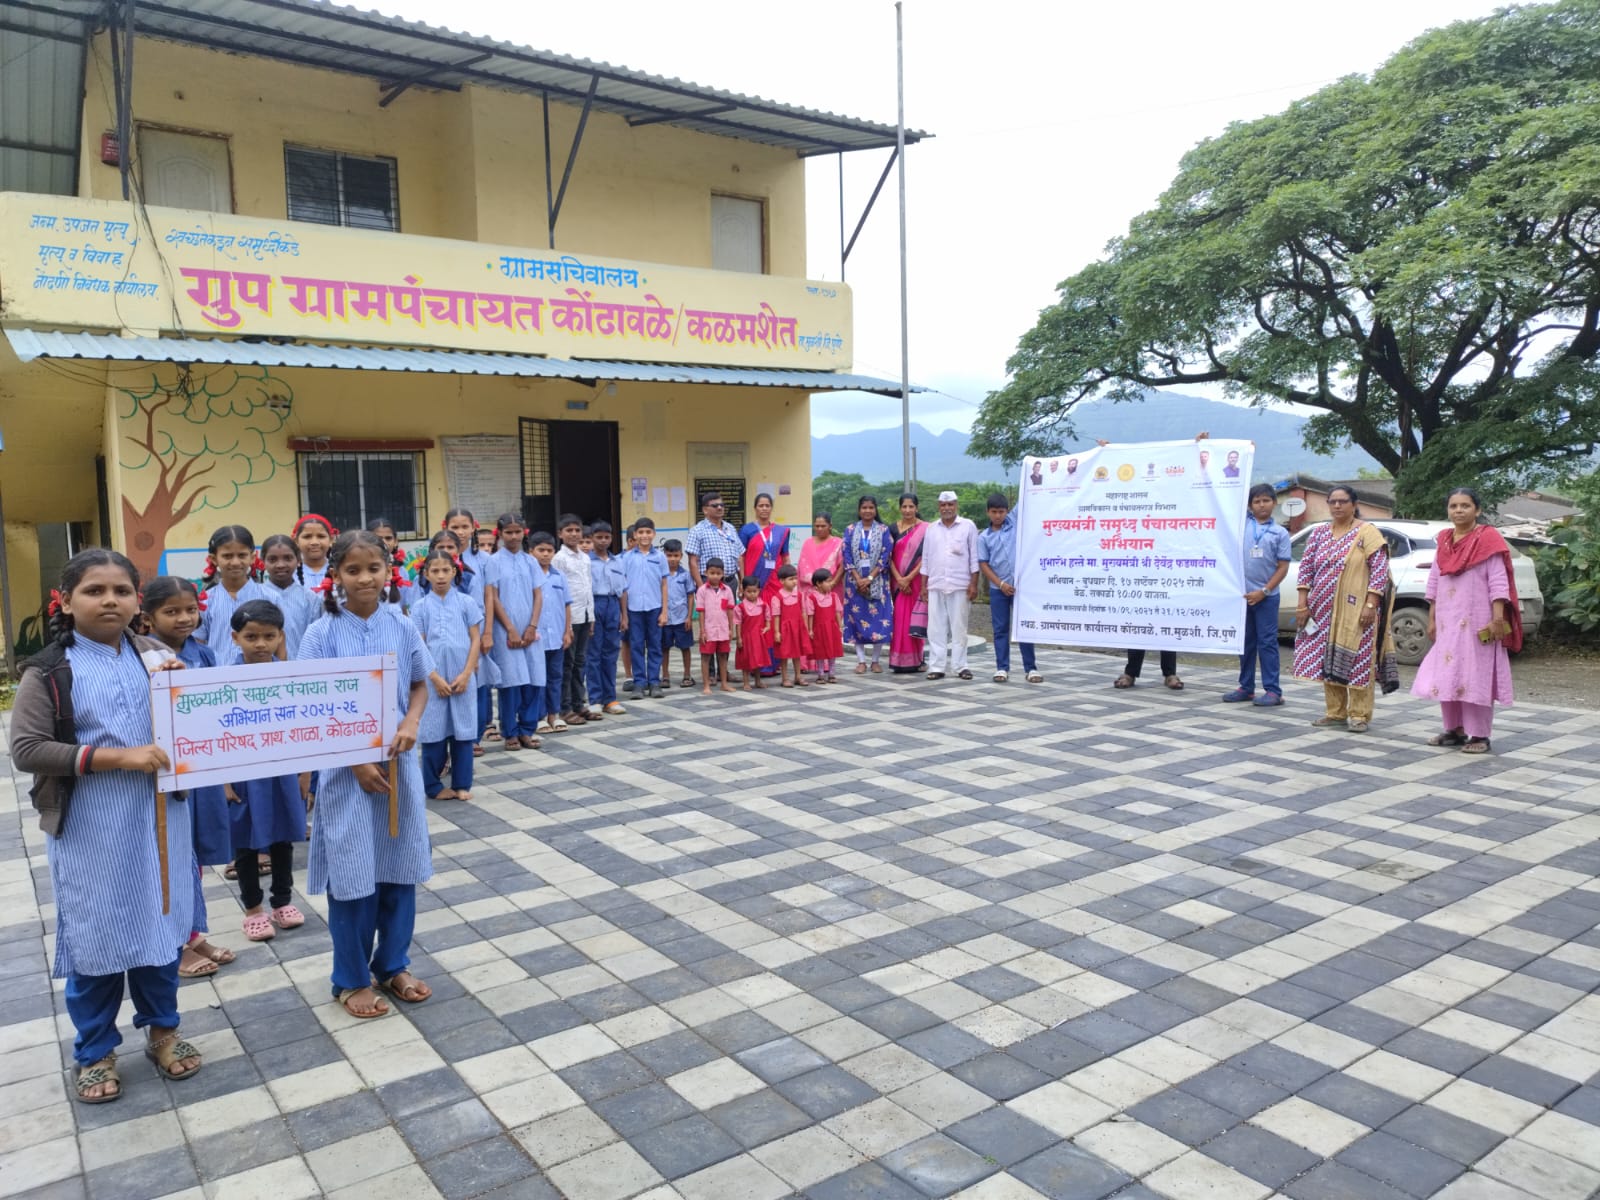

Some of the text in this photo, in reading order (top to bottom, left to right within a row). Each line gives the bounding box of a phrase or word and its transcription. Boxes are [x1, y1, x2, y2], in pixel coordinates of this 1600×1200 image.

[62, 217, 100, 233] उपजत
[68, 248, 79, 261] व
[82, 243, 124, 269] विवाह
[73, 271, 110, 294] निबंधक
[500, 256, 639, 289] ग्रामसचिवालय
[179, 267, 274, 330] ग्रुप
[281, 274, 545, 333] ग्रामपंचायत
[1042, 515, 1096, 536] मुख्यमंत्री
[1142, 515, 1216, 530] पंचायतराज
[1100, 533, 1155, 550] अभियान
[1040, 555, 1067, 570] शुभारंभ
[1102, 555, 1139, 571] मुख्यमंत्री
[1142, 556, 1151, 568] श्री
[1176, 556, 1216, 569] फडणवीस
[1048, 574, 1074, 585] अभियान
[1160, 577, 1184, 587] २०२५
[1040, 618, 1081, 632] ग्रामपंचायत
[1084, 620, 1117, 633] कार्यालय
[176, 684, 238, 714] मुख्यमंत्री
[283, 681, 327, 697] पंचायत
[334, 678, 359, 693] राज
[218, 707, 271, 728] अभियान
[273, 705, 297, 722] सन
[174, 736, 213, 758] जिल्हा
[215, 731, 258, 753] परिषद
